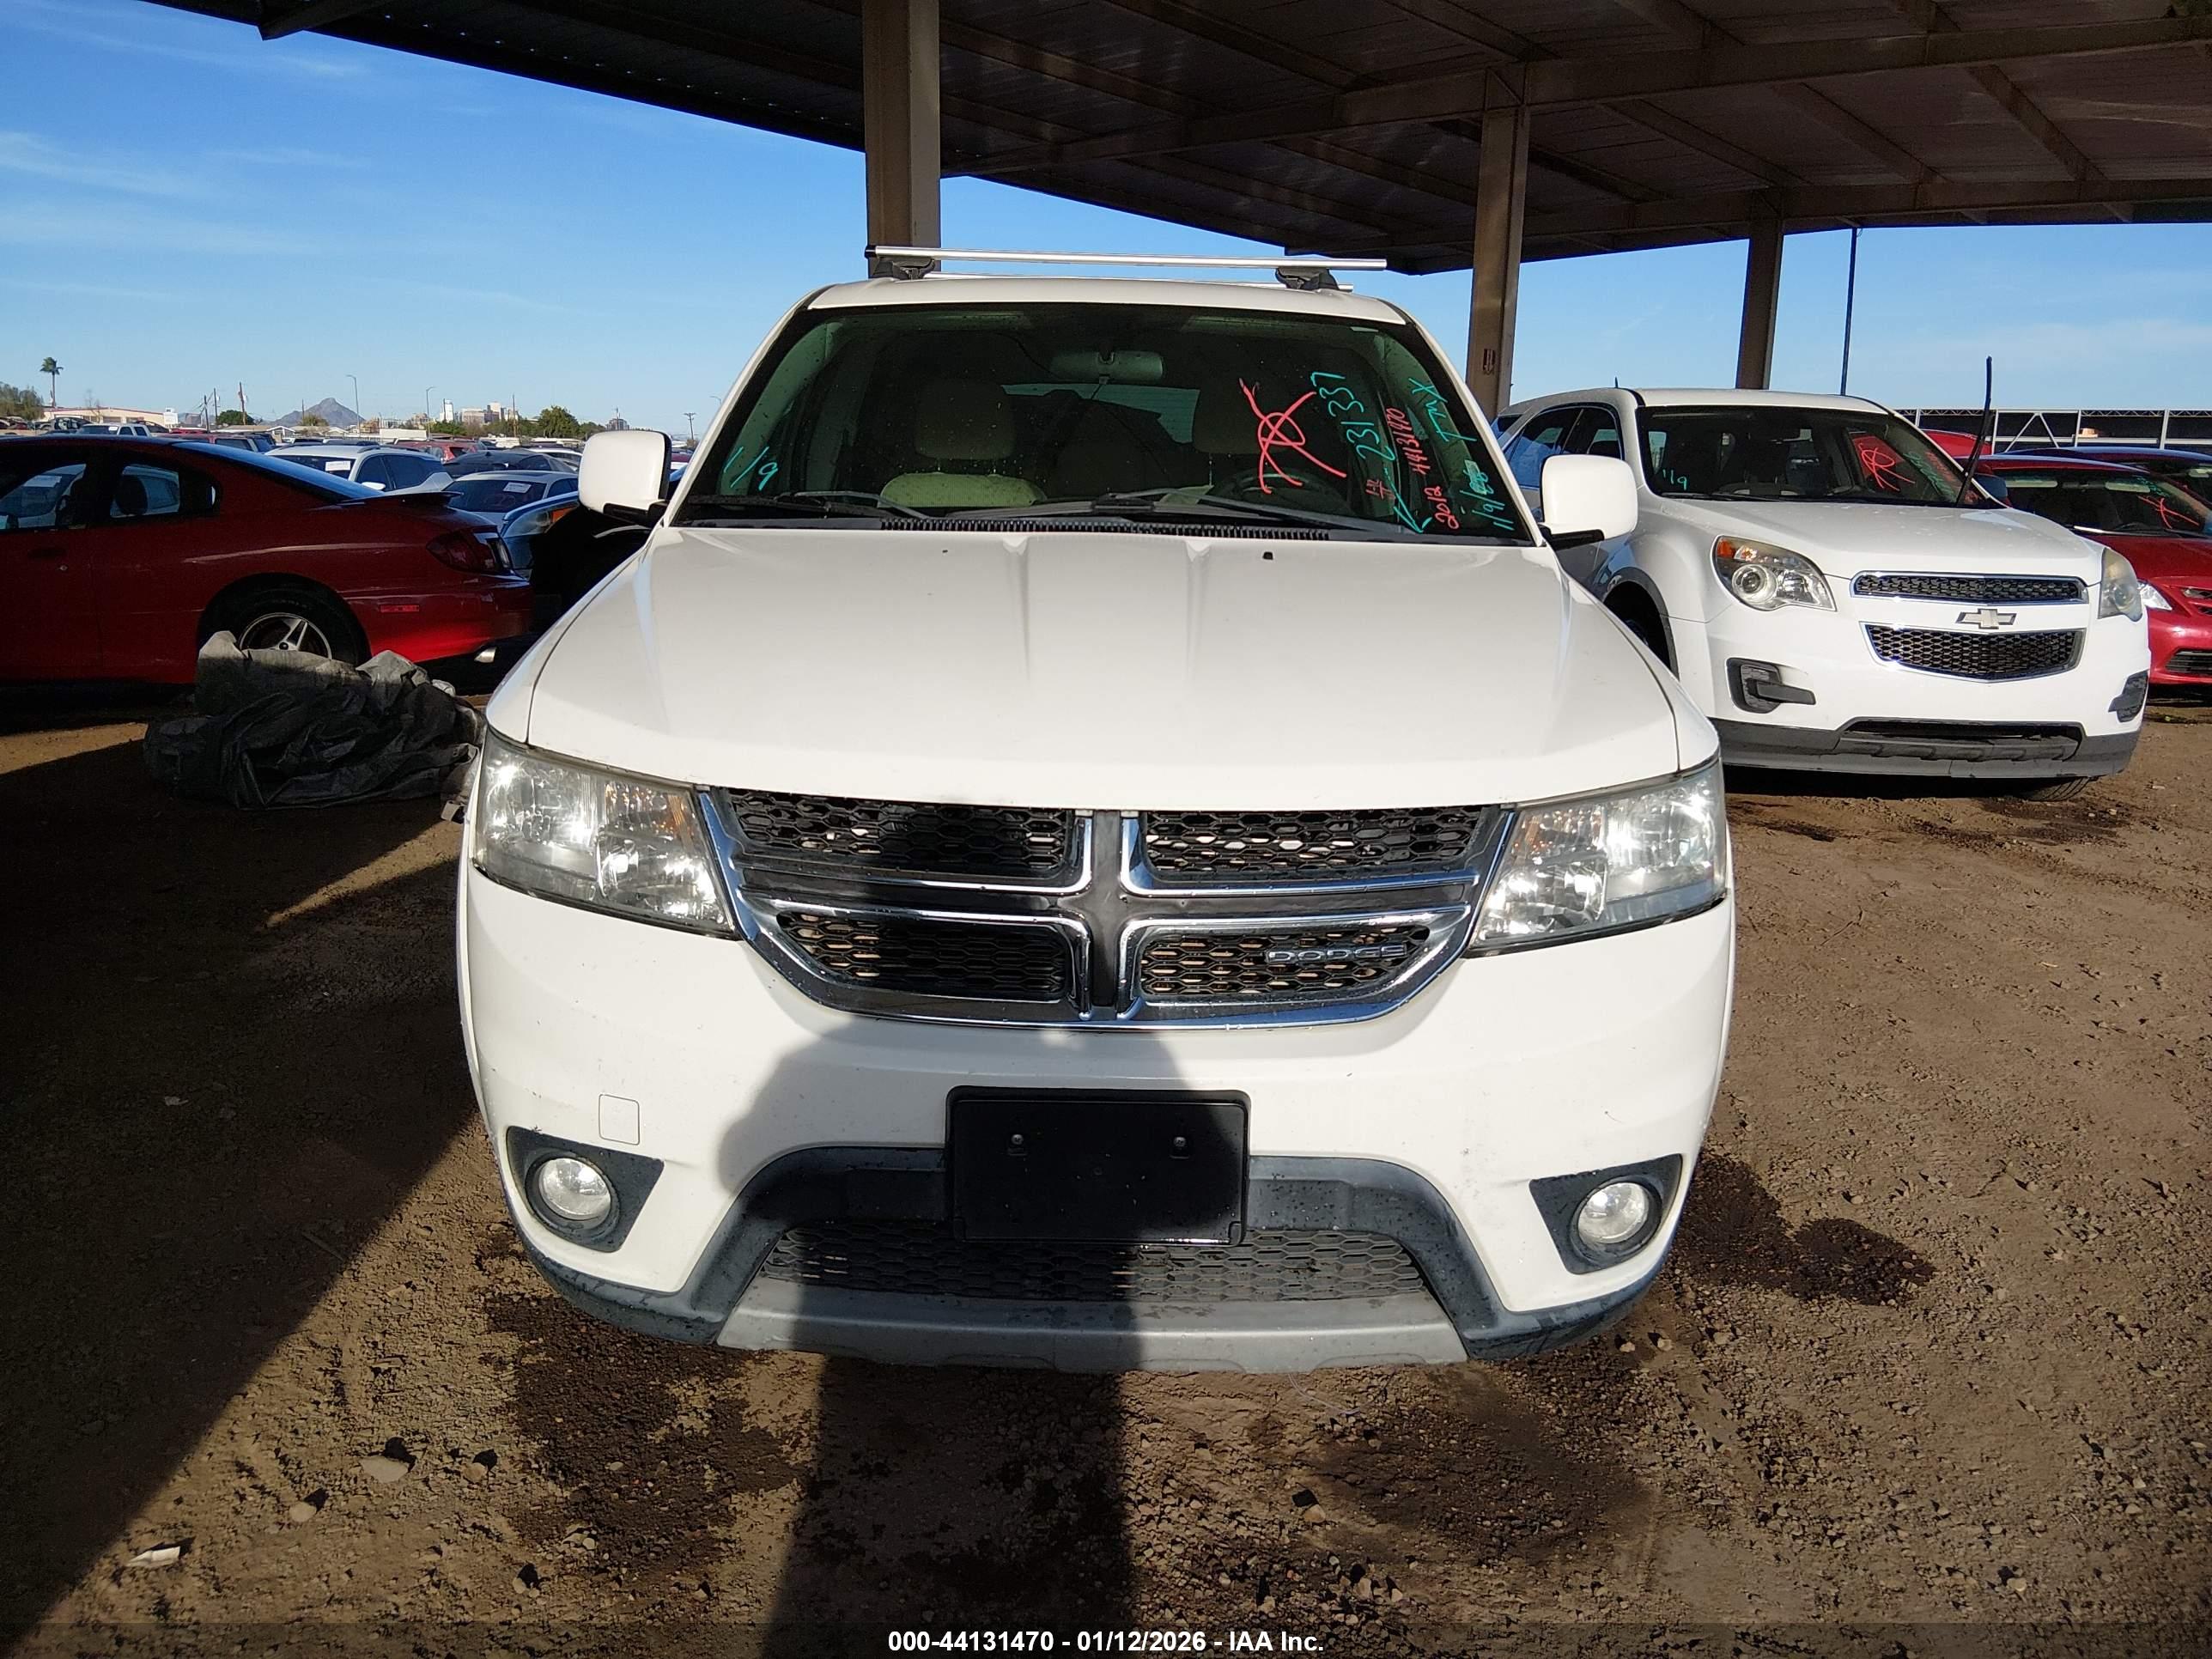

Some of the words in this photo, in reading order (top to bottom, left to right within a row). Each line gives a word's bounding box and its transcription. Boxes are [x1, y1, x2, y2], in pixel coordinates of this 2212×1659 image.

[1310, 372, 1395, 461] 231337
[1386, 408, 1431, 475] 44131470
[1424, 484, 1459, 531] 2012
[1267, 944, 1406, 963] DODGE
